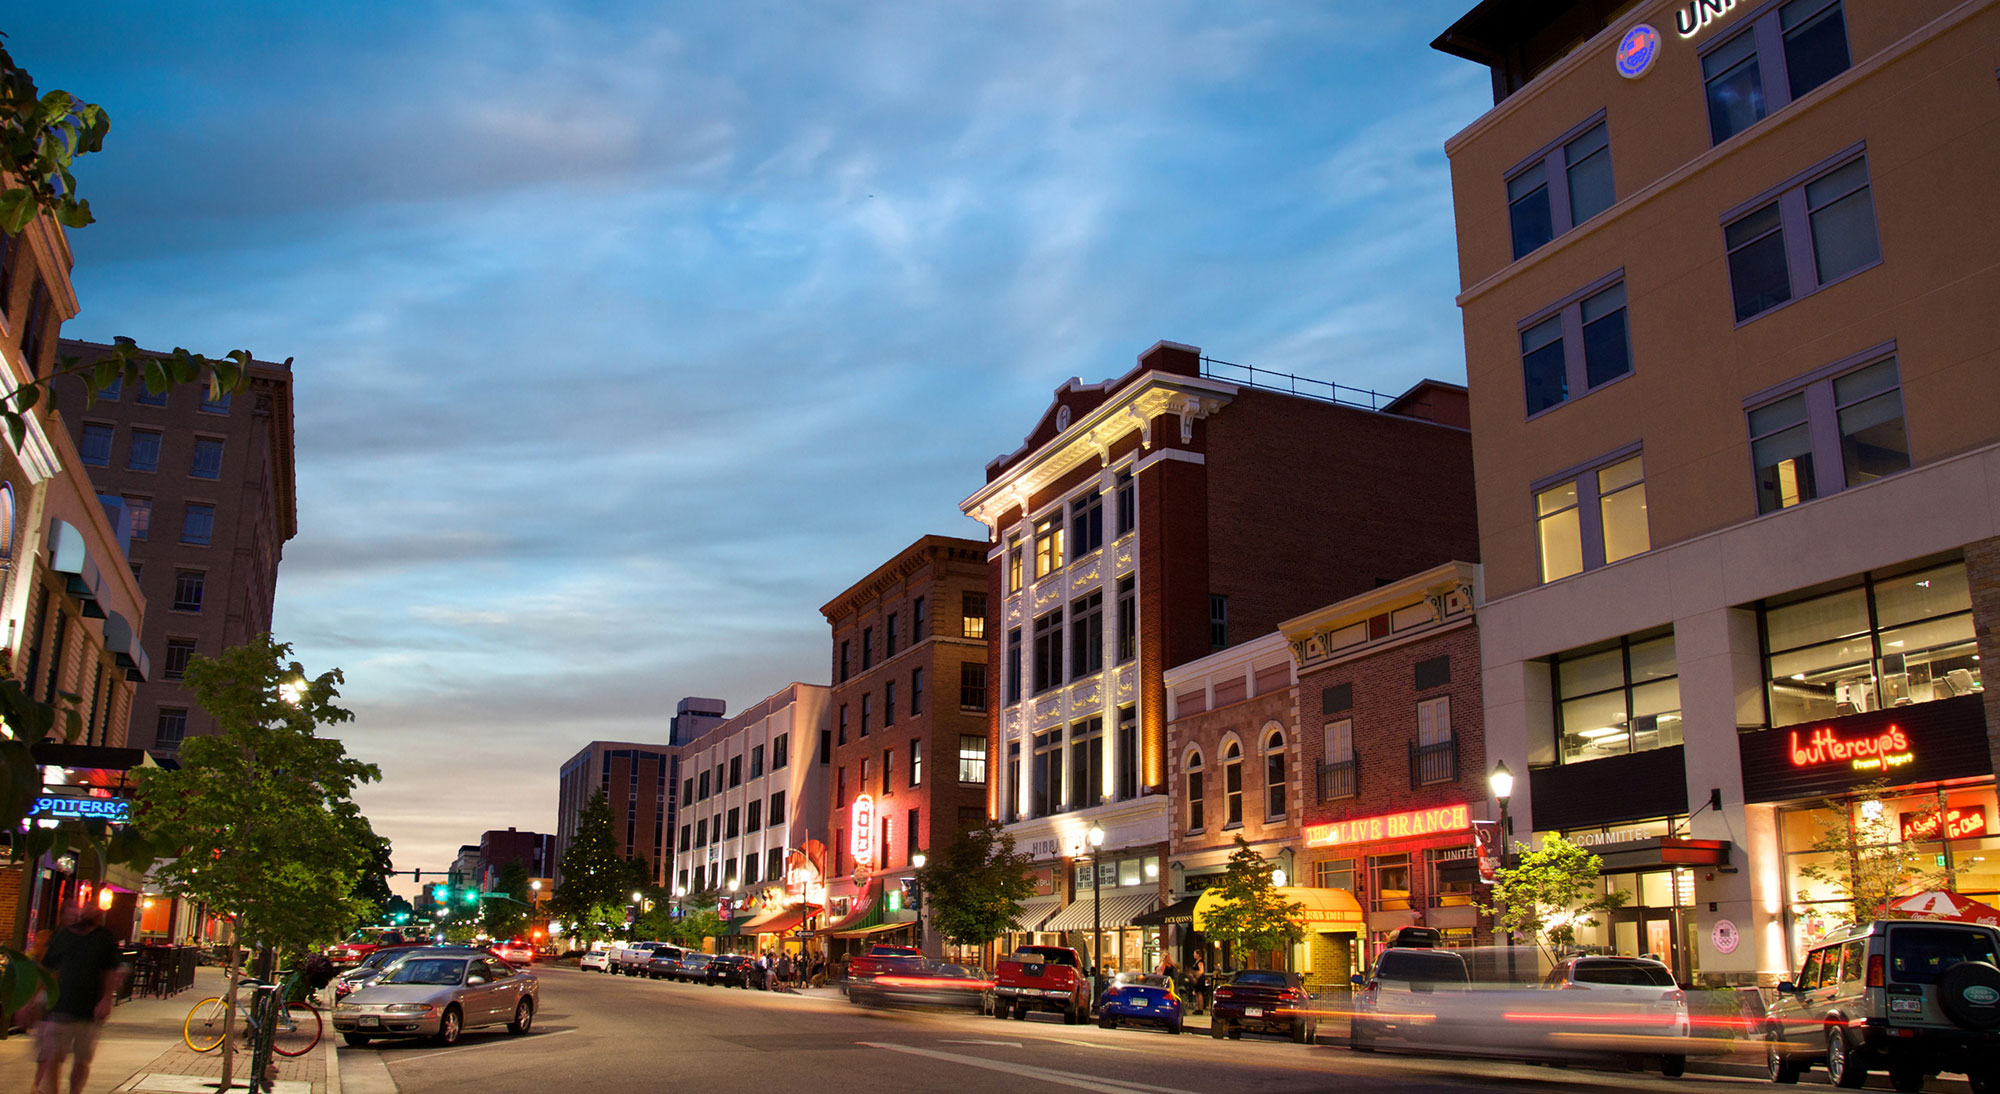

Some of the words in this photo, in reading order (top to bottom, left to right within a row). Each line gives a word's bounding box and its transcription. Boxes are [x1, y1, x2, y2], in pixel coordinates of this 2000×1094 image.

[1791, 724, 1908, 771] buttercup's
[1328, 818, 1382, 842] OLIVE
[1387, 806, 1467, 838] BRANCH
[1576, 827, 1652, 847] COMMITTEE
